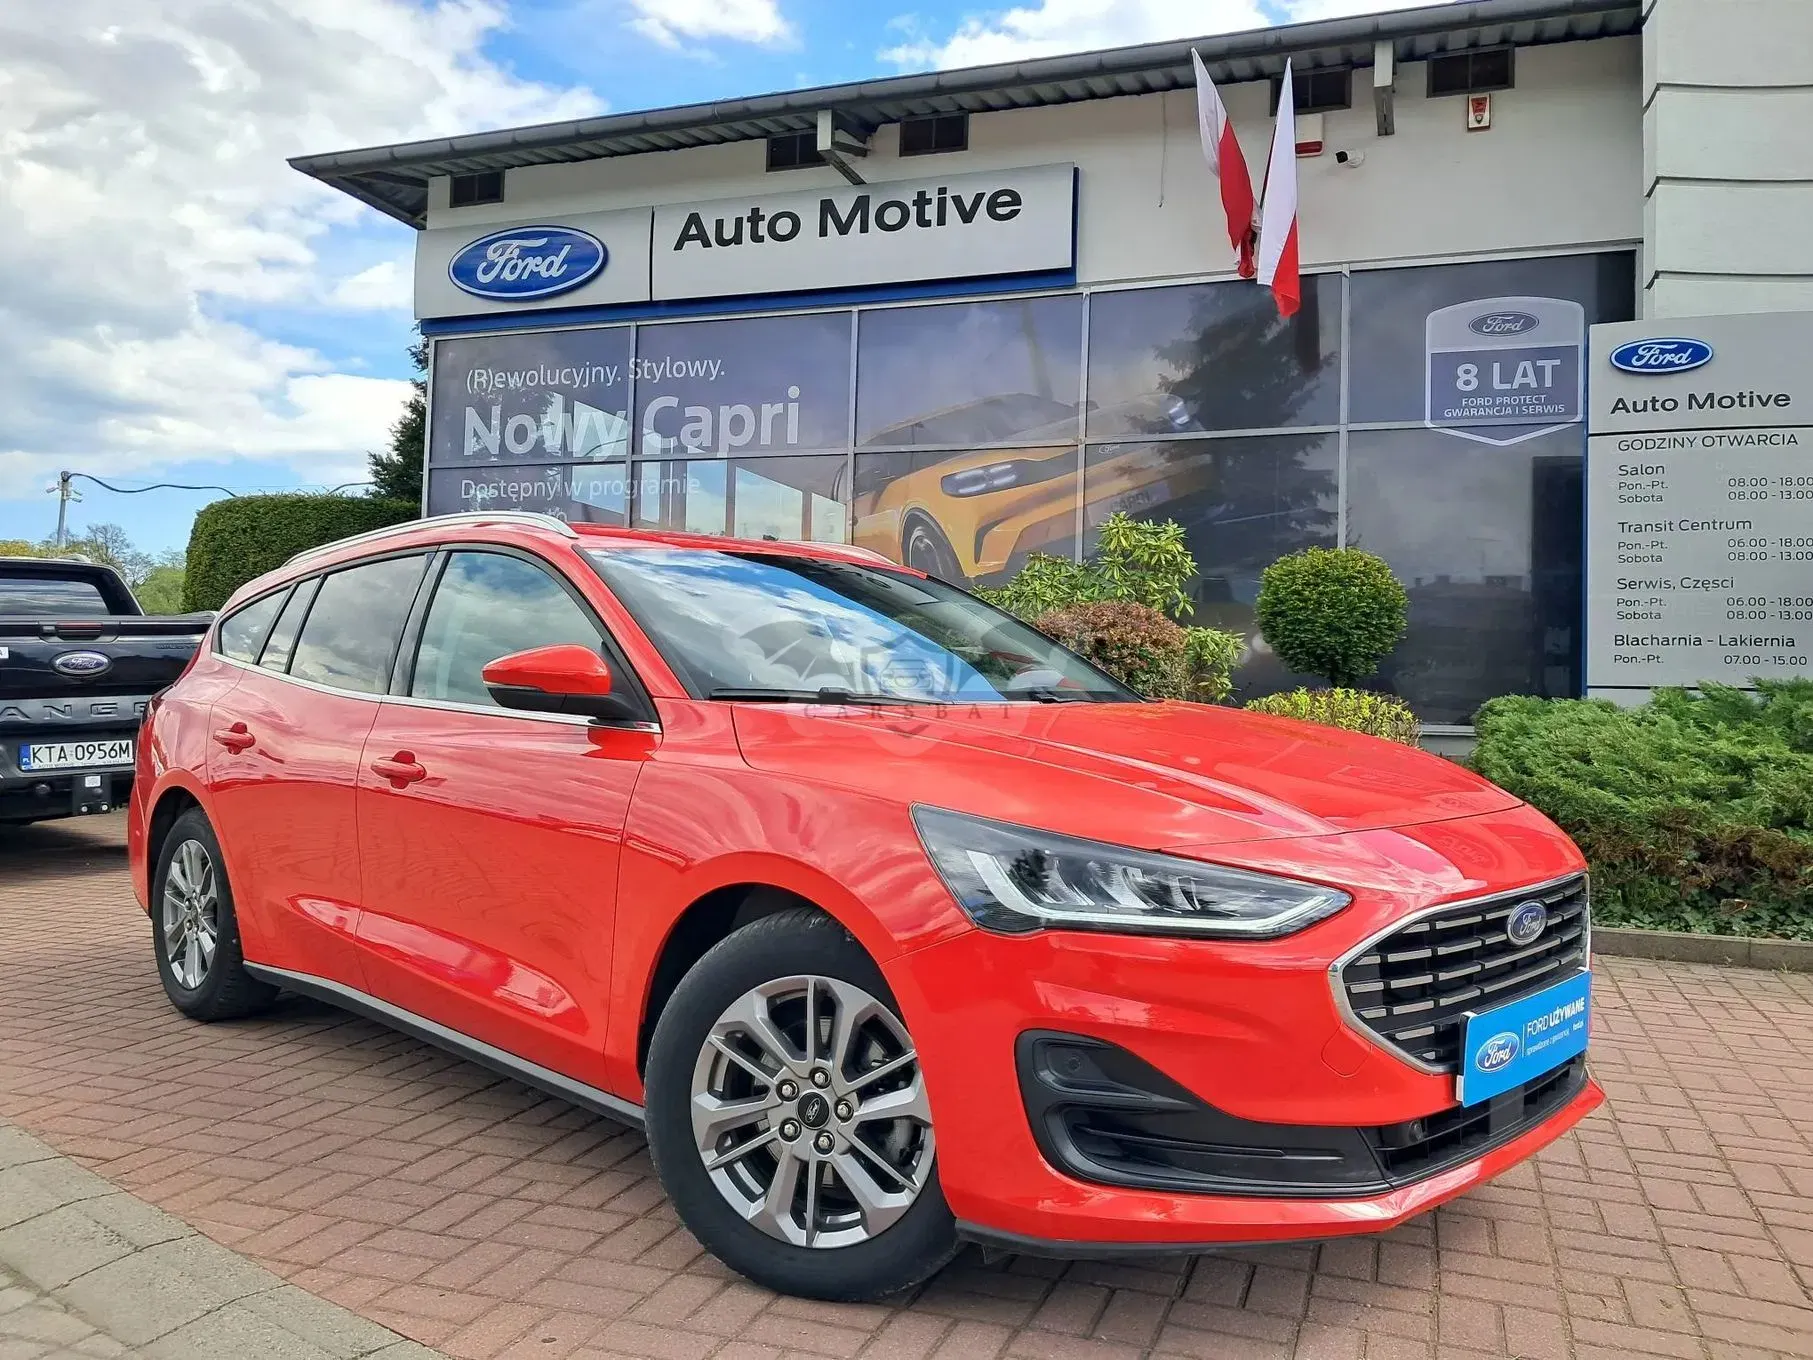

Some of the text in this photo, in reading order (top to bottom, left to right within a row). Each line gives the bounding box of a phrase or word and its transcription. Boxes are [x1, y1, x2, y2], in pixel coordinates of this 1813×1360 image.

[673, 185, 1022, 252] Auto Motive
[476, 237, 572, 284] Ford
[1482, 315, 1525, 333] Ford
[1631, 343, 1693, 366] Ford
[466, 355, 726, 394] (R)ewolucyjny. Stylowy.
[1456, 359, 1561, 391] 8 LAT
[1462, 395, 1547, 407] FORD PROTECT
[1610, 391, 1791, 415] Auto Motive
[1444, 404, 1565, 417] GWARANCJA I SERWIS
[463, 385, 800, 463] Nowy Capri
[1618, 434, 1798, 451] GODZINY OTWARCIA
[1618, 464, 1665, 476] Salon
[461, 473, 701, 502] Dostępny w programie
[1618, 480, 1668, 490] Pon.-Pt.
[1728, 477, 1768, 487] 08.00
[1779, 477, 1813, 487] 18.00
[1618, 494, 1663, 503] Sobota
[1728, 491, 1768, 500] 08.00
[1779, 490, 1813, 500] 13.00
[1618, 519, 1752, 533] Transit Centrum
[1618, 540, 1668, 550] Pon.-Pt.
[1728, 538, 1767, 548] 06.00
[1779, 538, 1813, 548] 18.00
[1618, 554, 1663, 563] Sobota
[1728, 551, 1768, 561] 08.00
[1779, 551, 1813, 561] 13.00
[1617, 578, 1676, 591] Serwis,
[1616, 598, 1667, 607] Pon.-Pt.
[1726, 597, 1766, 607] 06.00
[1778, 597, 1813, 607] 18.00
[1616, 611, 1662, 620] Sobota
[1726, 610, 1766, 620] 08.00
[1778, 610, 1813, 620] 13.00
[1614, 634, 1702, 647] Blacharnia
[1719, 634, 1796, 648] Lakiernia
[69, 657, 98, 668] Ford
[1614, 654, 1664, 664] Pon.-Pt.
[1724, 655, 1761, 665] 07.00
[1773, 655, 1807, 666] 15.00
[32, 745, 68, 764] KTA
[75, 742, 130, 761] 0956M
[1519, 911, 1542, 936] Ford
[1527, 1015, 1549, 1038] FORD
[1549, 996, 1585, 1027] UŻYWANE
[1484, 1038, 1512, 1068] Ford
